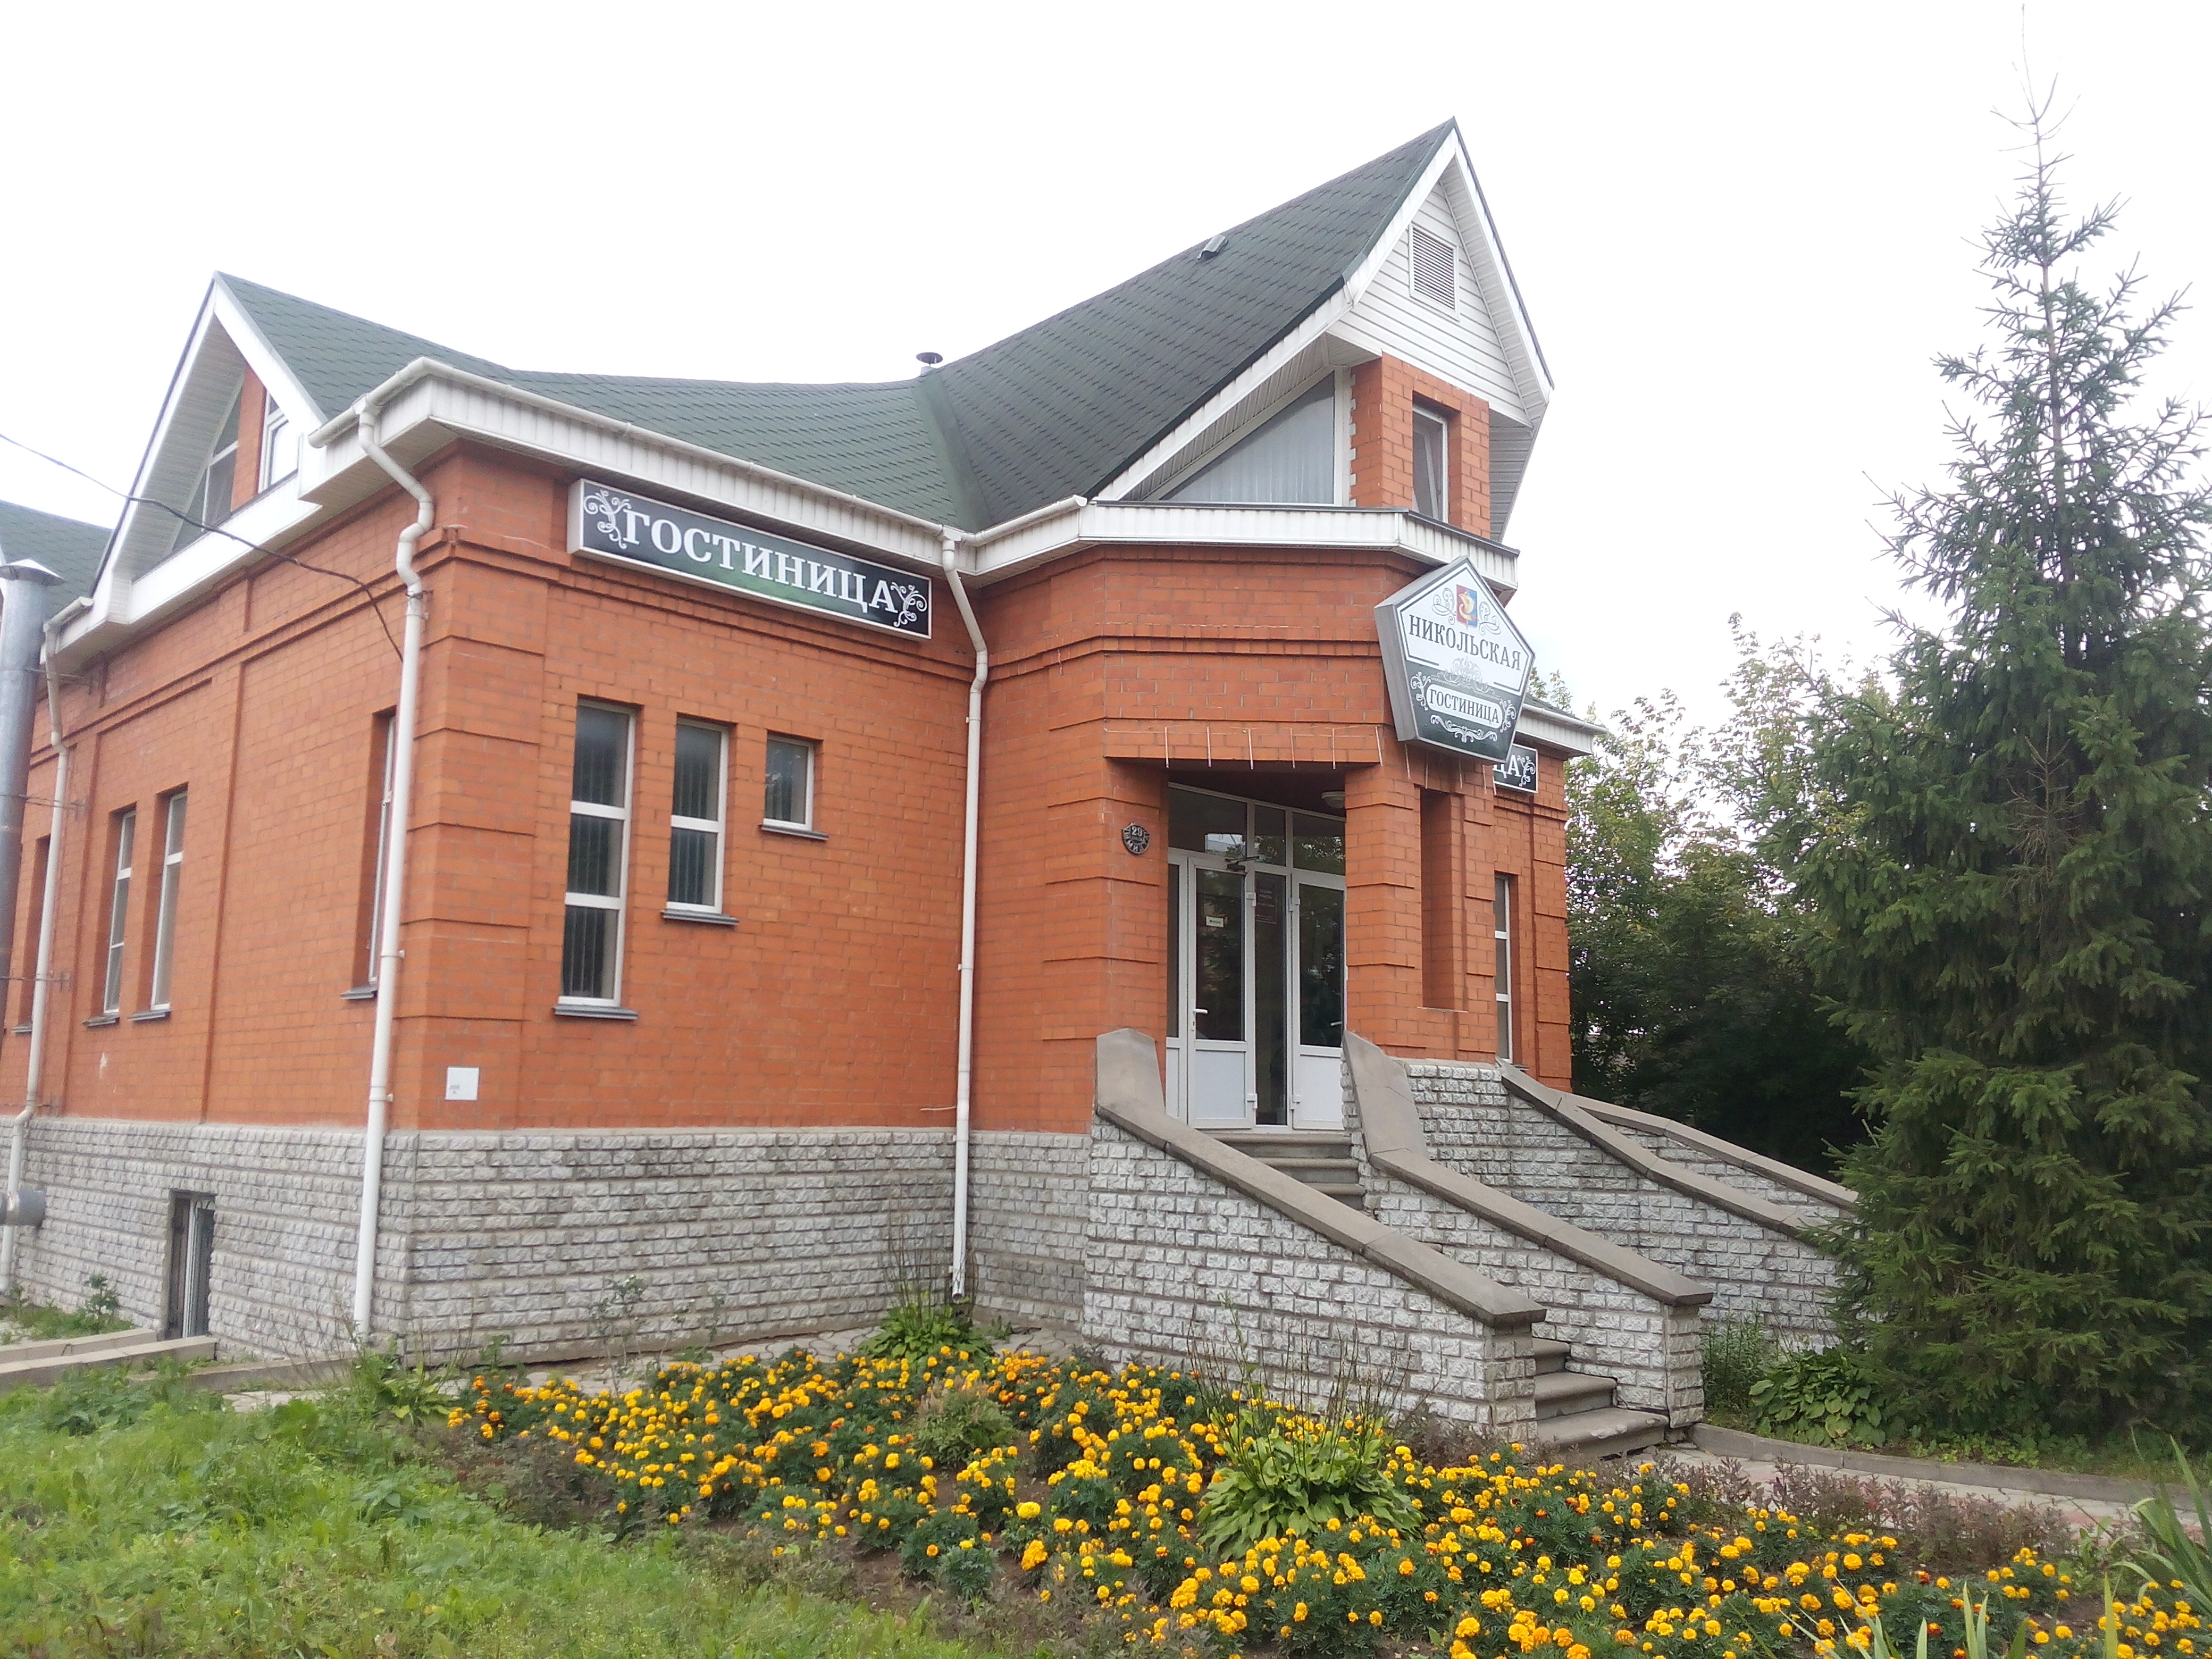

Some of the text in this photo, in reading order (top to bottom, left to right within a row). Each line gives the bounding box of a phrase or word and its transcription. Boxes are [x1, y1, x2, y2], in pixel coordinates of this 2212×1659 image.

[624, 509, 899, 615] ГОСТИНИЦА
[1409, 615, 1521, 671] НИКОЛЬСКАЯ
[1430, 689, 1499, 725] ГОСТИНИЦА
[1132, 826, 1143, 836] 29
